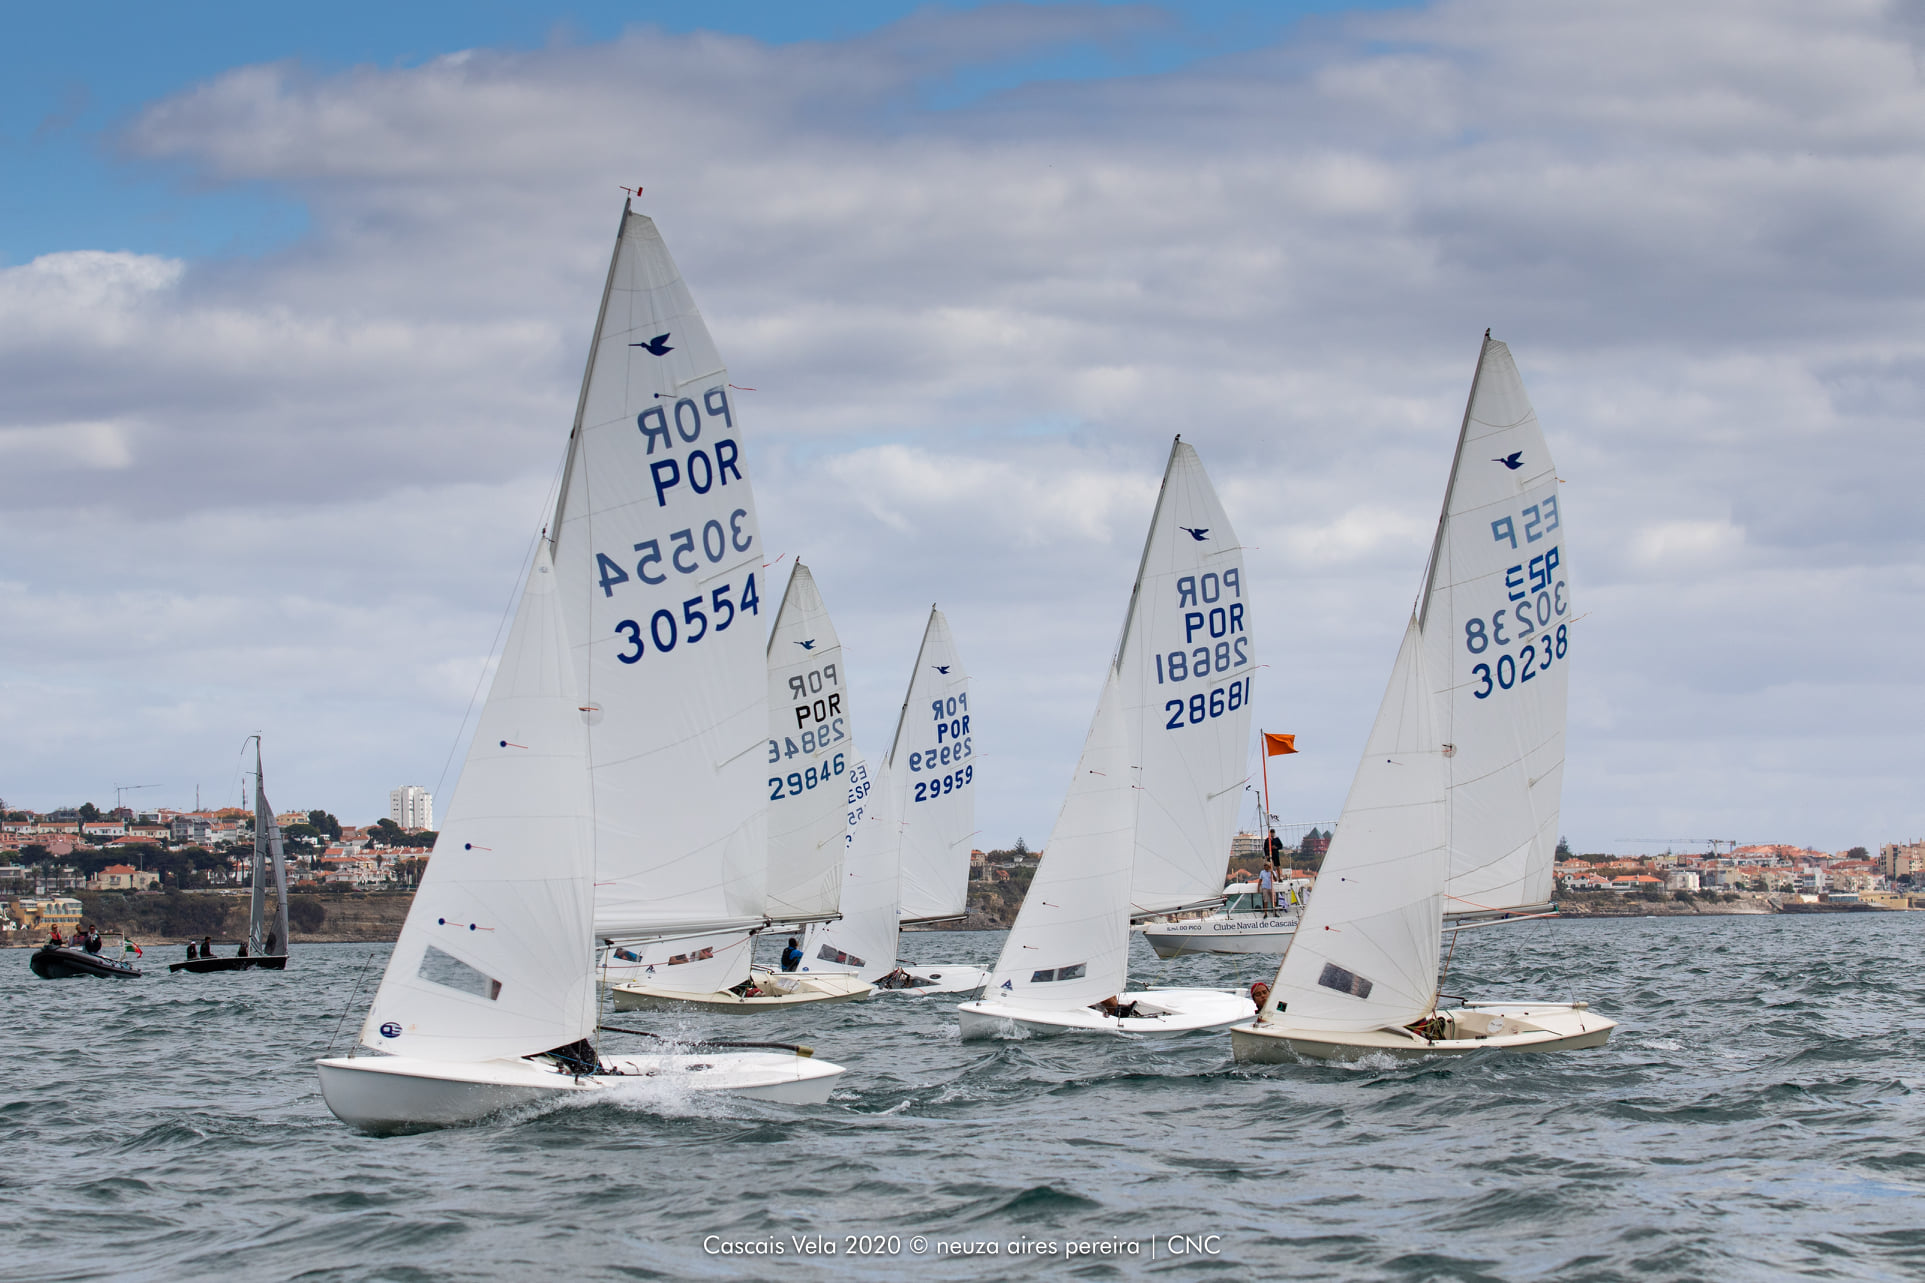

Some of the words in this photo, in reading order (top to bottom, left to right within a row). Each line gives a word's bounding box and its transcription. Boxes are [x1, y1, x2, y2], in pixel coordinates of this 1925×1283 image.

[650, 438, 742, 507] POR
[1505, 545, 1560, 602] ESP
[614, 572, 760, 664] 30554
[1185, 602, 1244, 644] POR
[1471, 623, 1568, 699] 30238
[795, 693, 841, 729] POR
[1165, 677, 1250, 730] 28681
[937, 715, 970, 744] POR
[768, 753, 845, 801] 29846
[848, 781, 871, 804] ESP
[914, 765, 973, 802] 29959
[1213, 923, 1236, 931] Clube
[1236, 921, 1259, 930] Naval
[1259, 921, 1269, 929] de
[1269, 919, 1298, 928] Cascais
